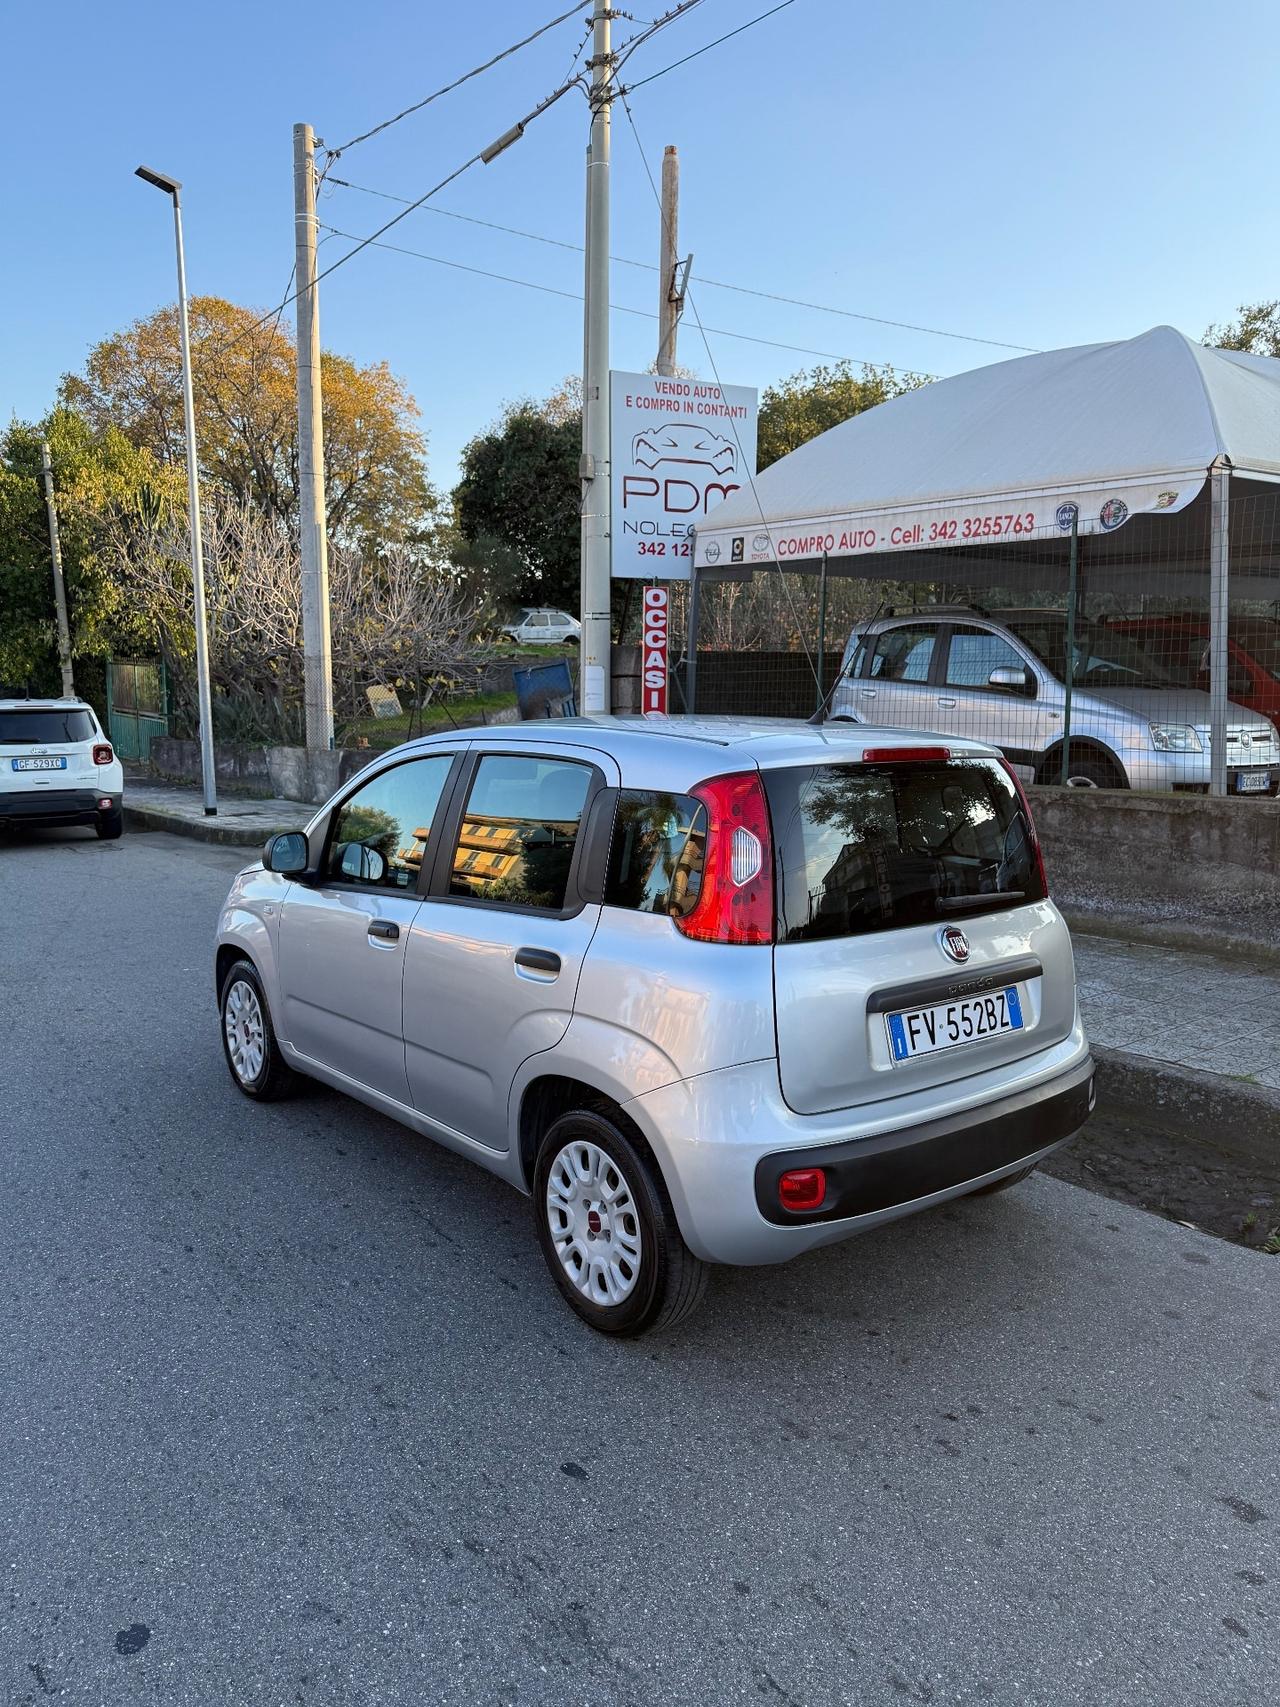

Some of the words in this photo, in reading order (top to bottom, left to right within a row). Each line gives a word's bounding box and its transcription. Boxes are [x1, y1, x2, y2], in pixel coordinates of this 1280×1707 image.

[654, 381, 690, 397] VENDO
[693, 386, 721, 400] AUTO
[626, 395, 633, 407] E
[636, 396, 680, 412] COMPRO
[683, 401, 694, 414] IN
[697, 403, 747, 419] CONTANTI
[777, 534, 835, 556] COMPRO
[838, 529, 876, 549] AUTO
[891, 524, 925, 545] Cell:
[928, 520, 958, 541] 342
[961, 512, 1035, 538] 3255763
[638, 541, 666, 556] 342
[671, 543, 693, 557] 12
[644, 588, 668, 717] OCCASI
[949, 936, 968, 952] FIAT
[946, 995, 1010, 1041] 552BZ
